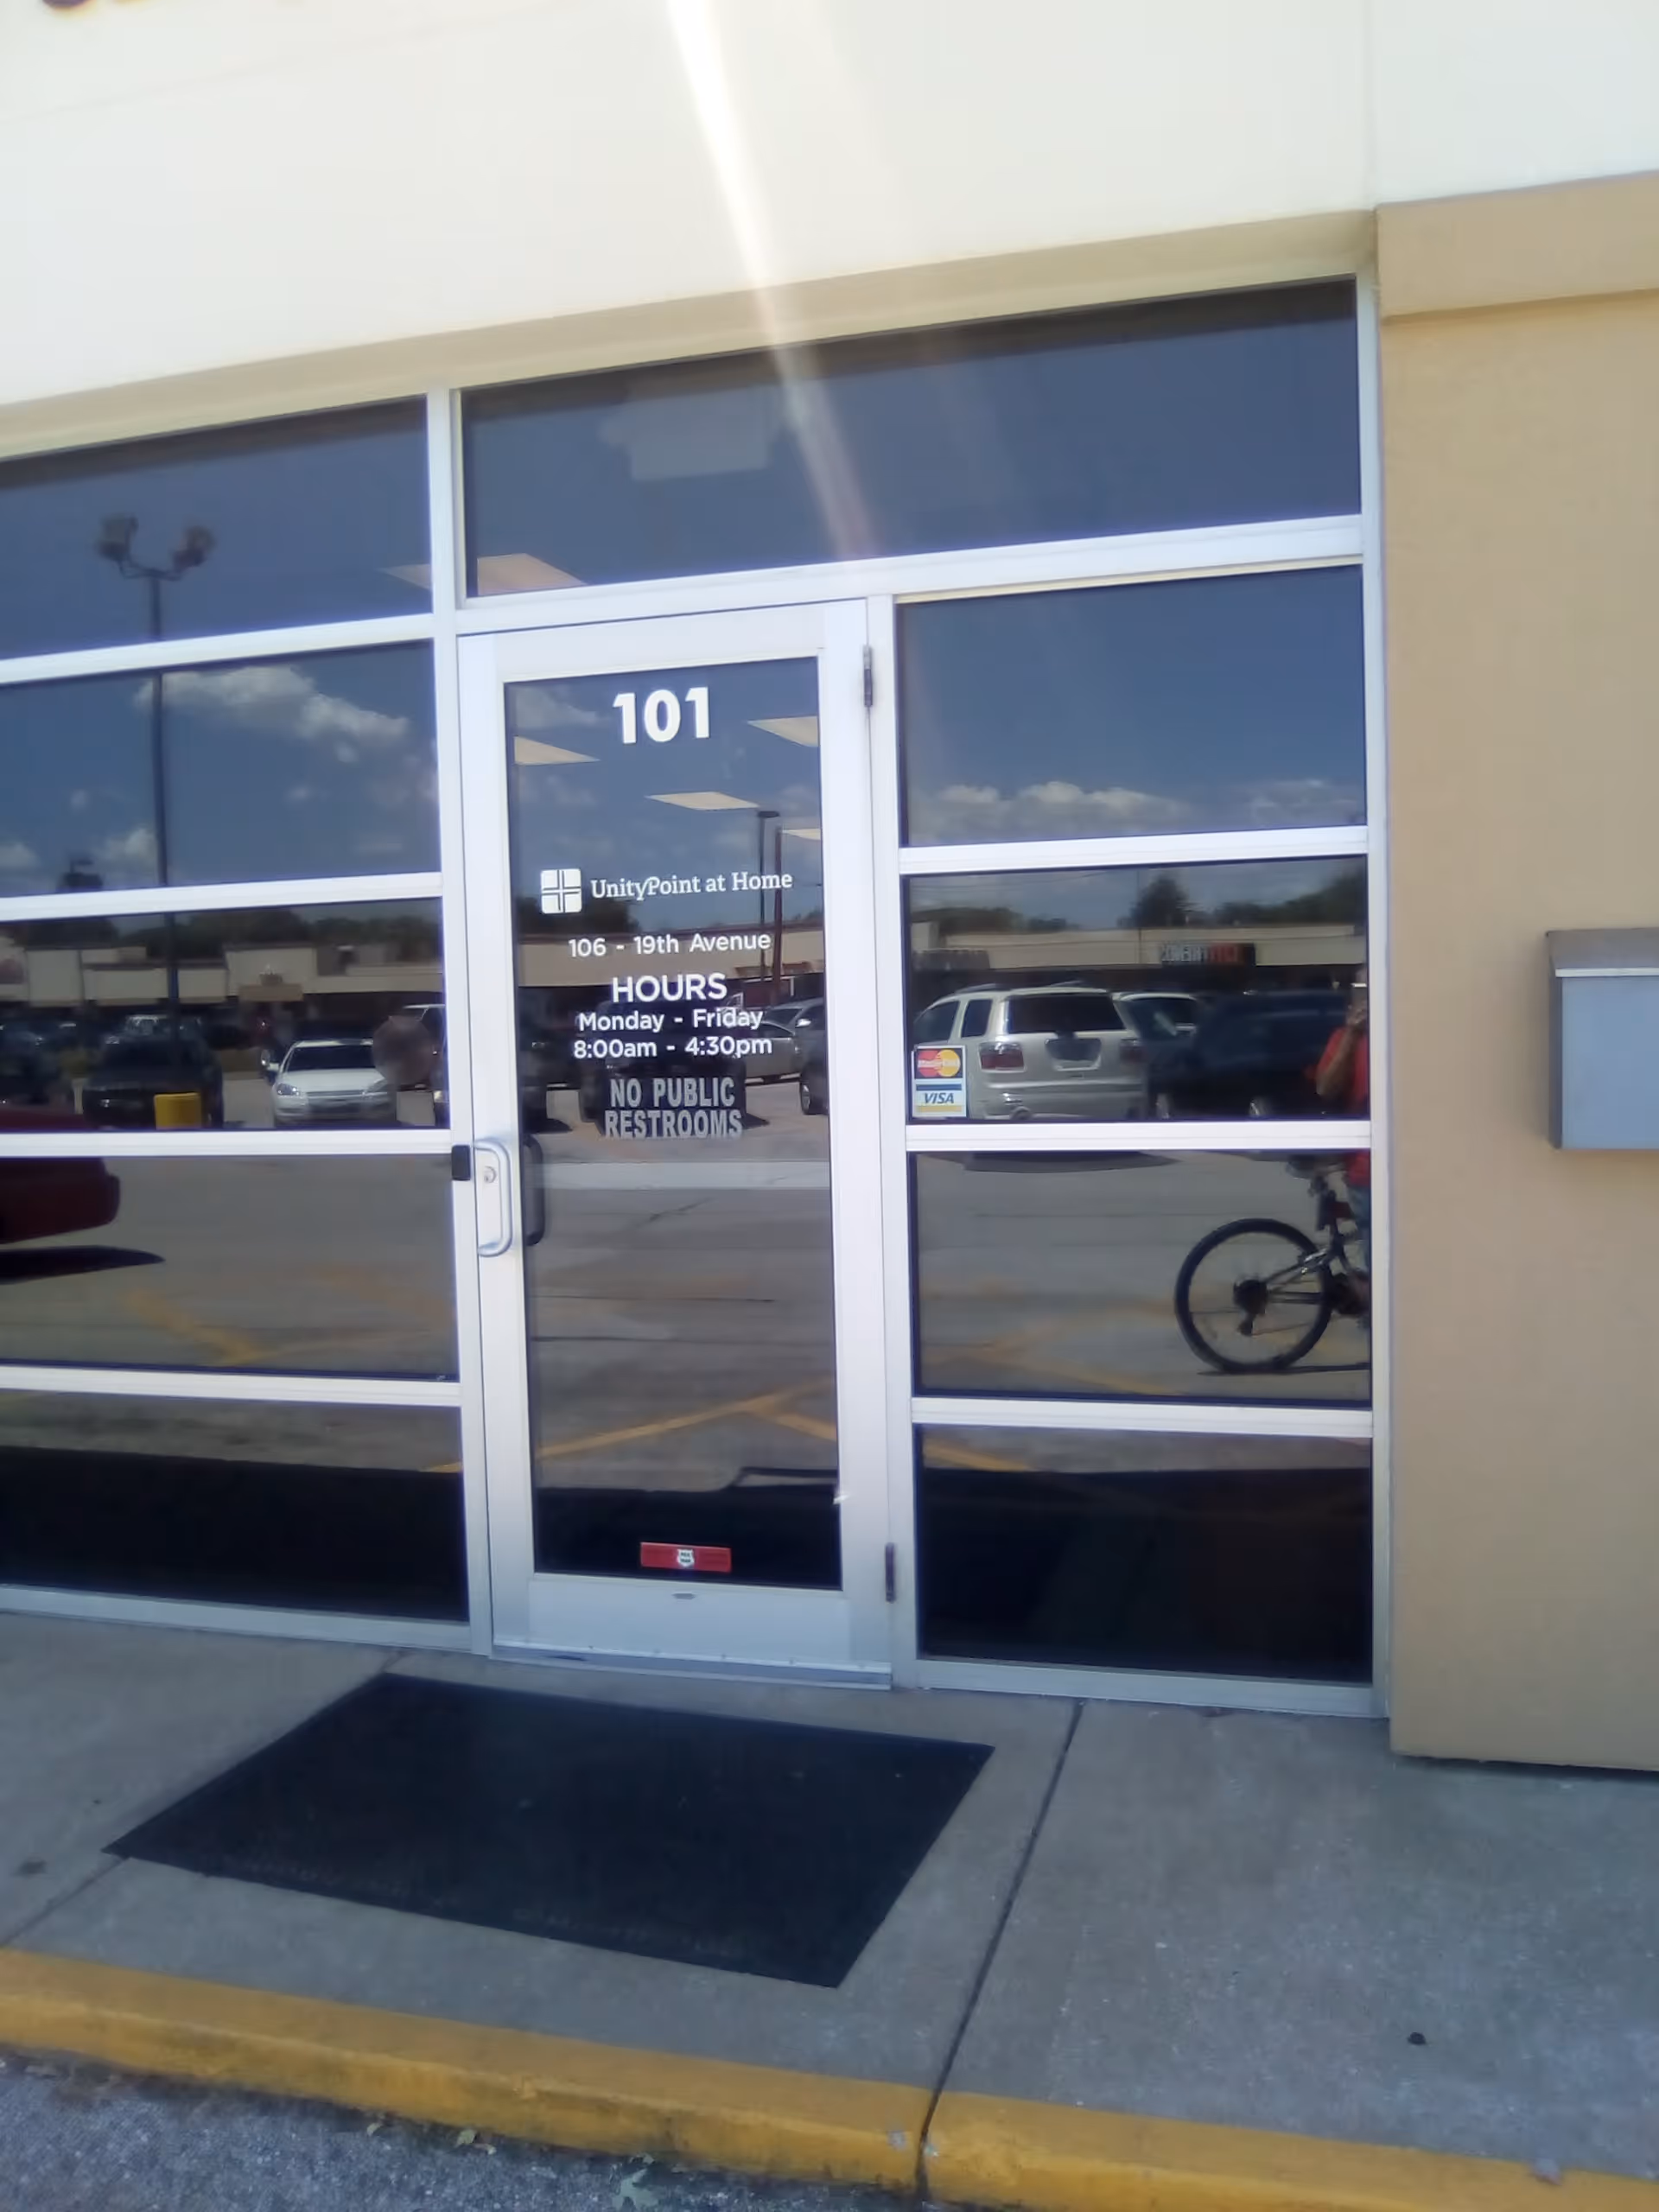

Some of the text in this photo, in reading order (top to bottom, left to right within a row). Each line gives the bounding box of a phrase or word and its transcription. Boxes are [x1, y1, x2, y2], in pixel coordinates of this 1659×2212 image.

[613, 687, 709, 744] 101
[591, 871, 793, 901] UnityPoint at Home
[568, 938, 606, 957] 106
[633, 934, 679, 955] 19th
[689, 933, 772, 953] Avenue
[612, 972, 728, 1003] HOURS
[579, 1010, 664, 1033] Monday
[693, 1007, 763, 1030] Friday
[574, 1039, 658, 1059] 8:00am
[684, 1036, 772, 1058] 4:30pm
[610, 1077, 735, 1108] NO PUBLIC
[924, 1092, 955, 1104] VISA
[604, 1109, 743, 1140] RESTROOMS
